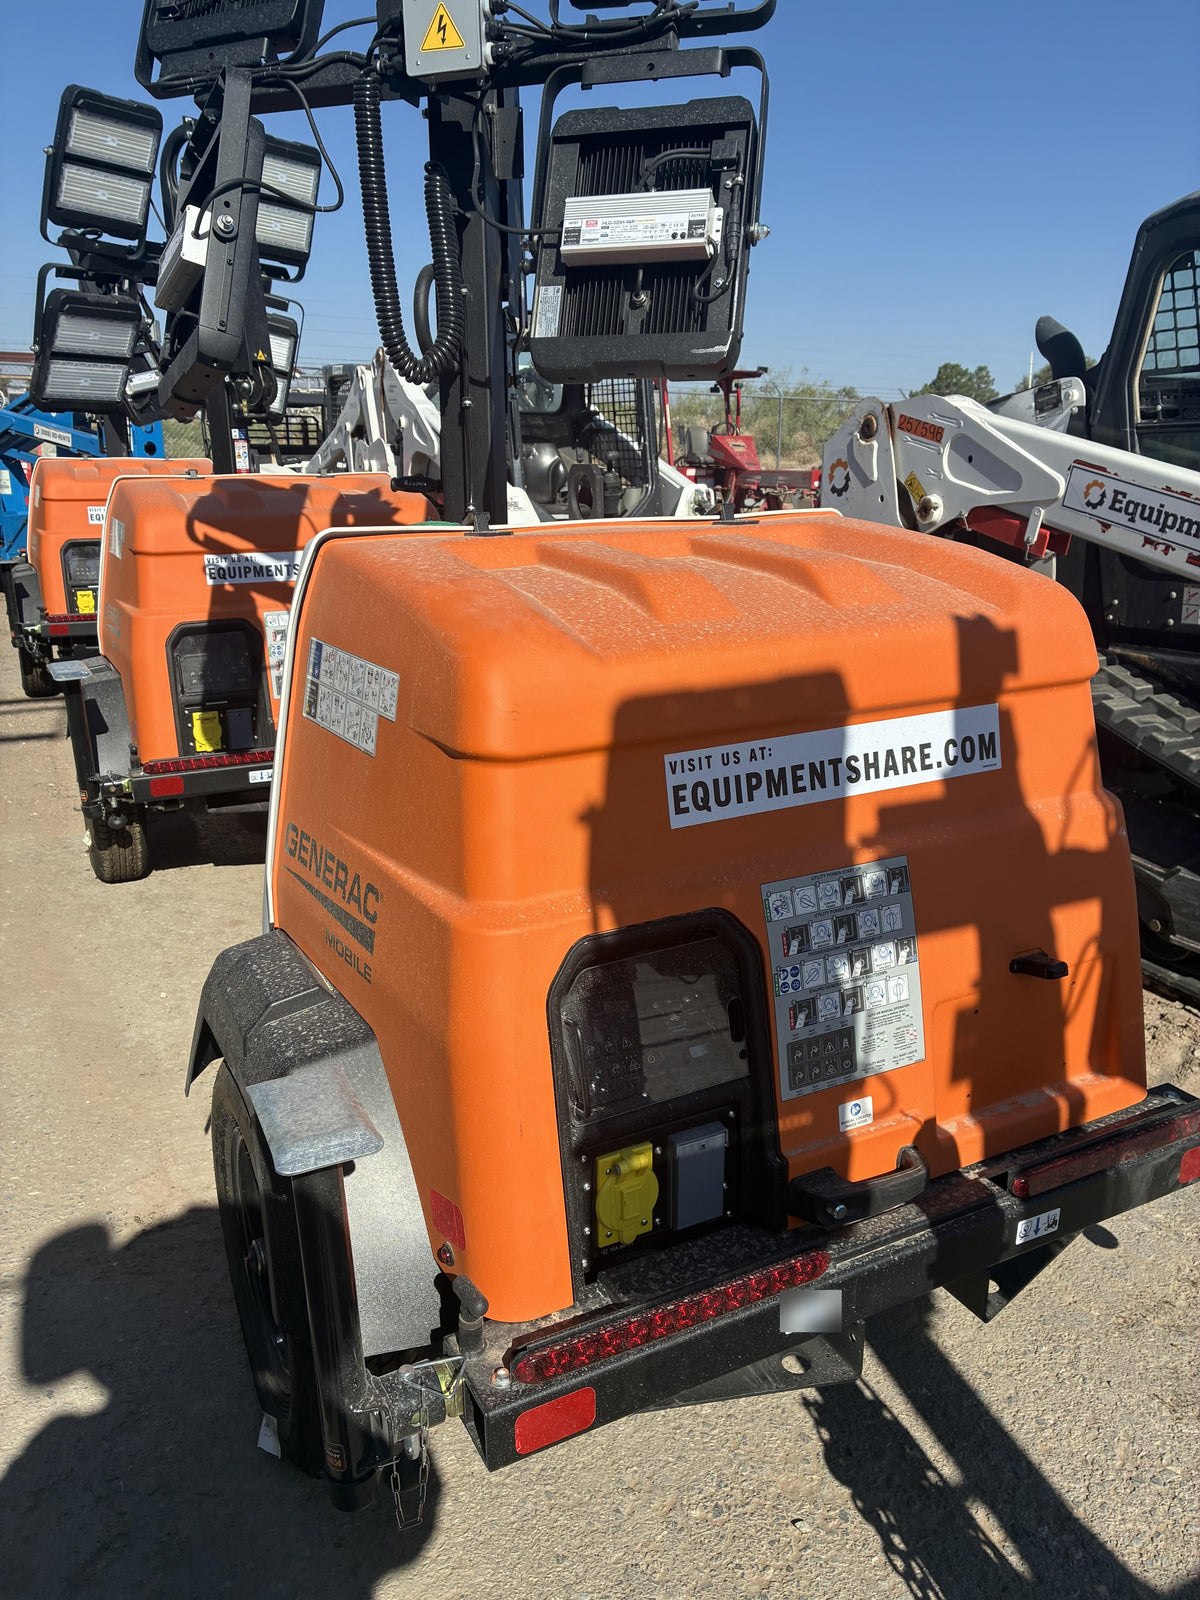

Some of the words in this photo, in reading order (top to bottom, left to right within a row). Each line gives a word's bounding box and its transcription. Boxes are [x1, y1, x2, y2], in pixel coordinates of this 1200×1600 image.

[898, 415, 944, 443] 257596
[1108, 488, 1200, 539] Equipm
[206, 556, 228, 564] VISIT
[208, 563, 300, 580] EQUIPMENTS
[669, 754, 713, 776] VISIT
[721, 750, 742, 768] US
[749, 746, 773, 763] AT:
[672, 731, 998, 816] EQUIPMENTSHARE.COM
[284, 822, 380, 925] GENERAC
[325, 927, 372, 985] MOBILE
